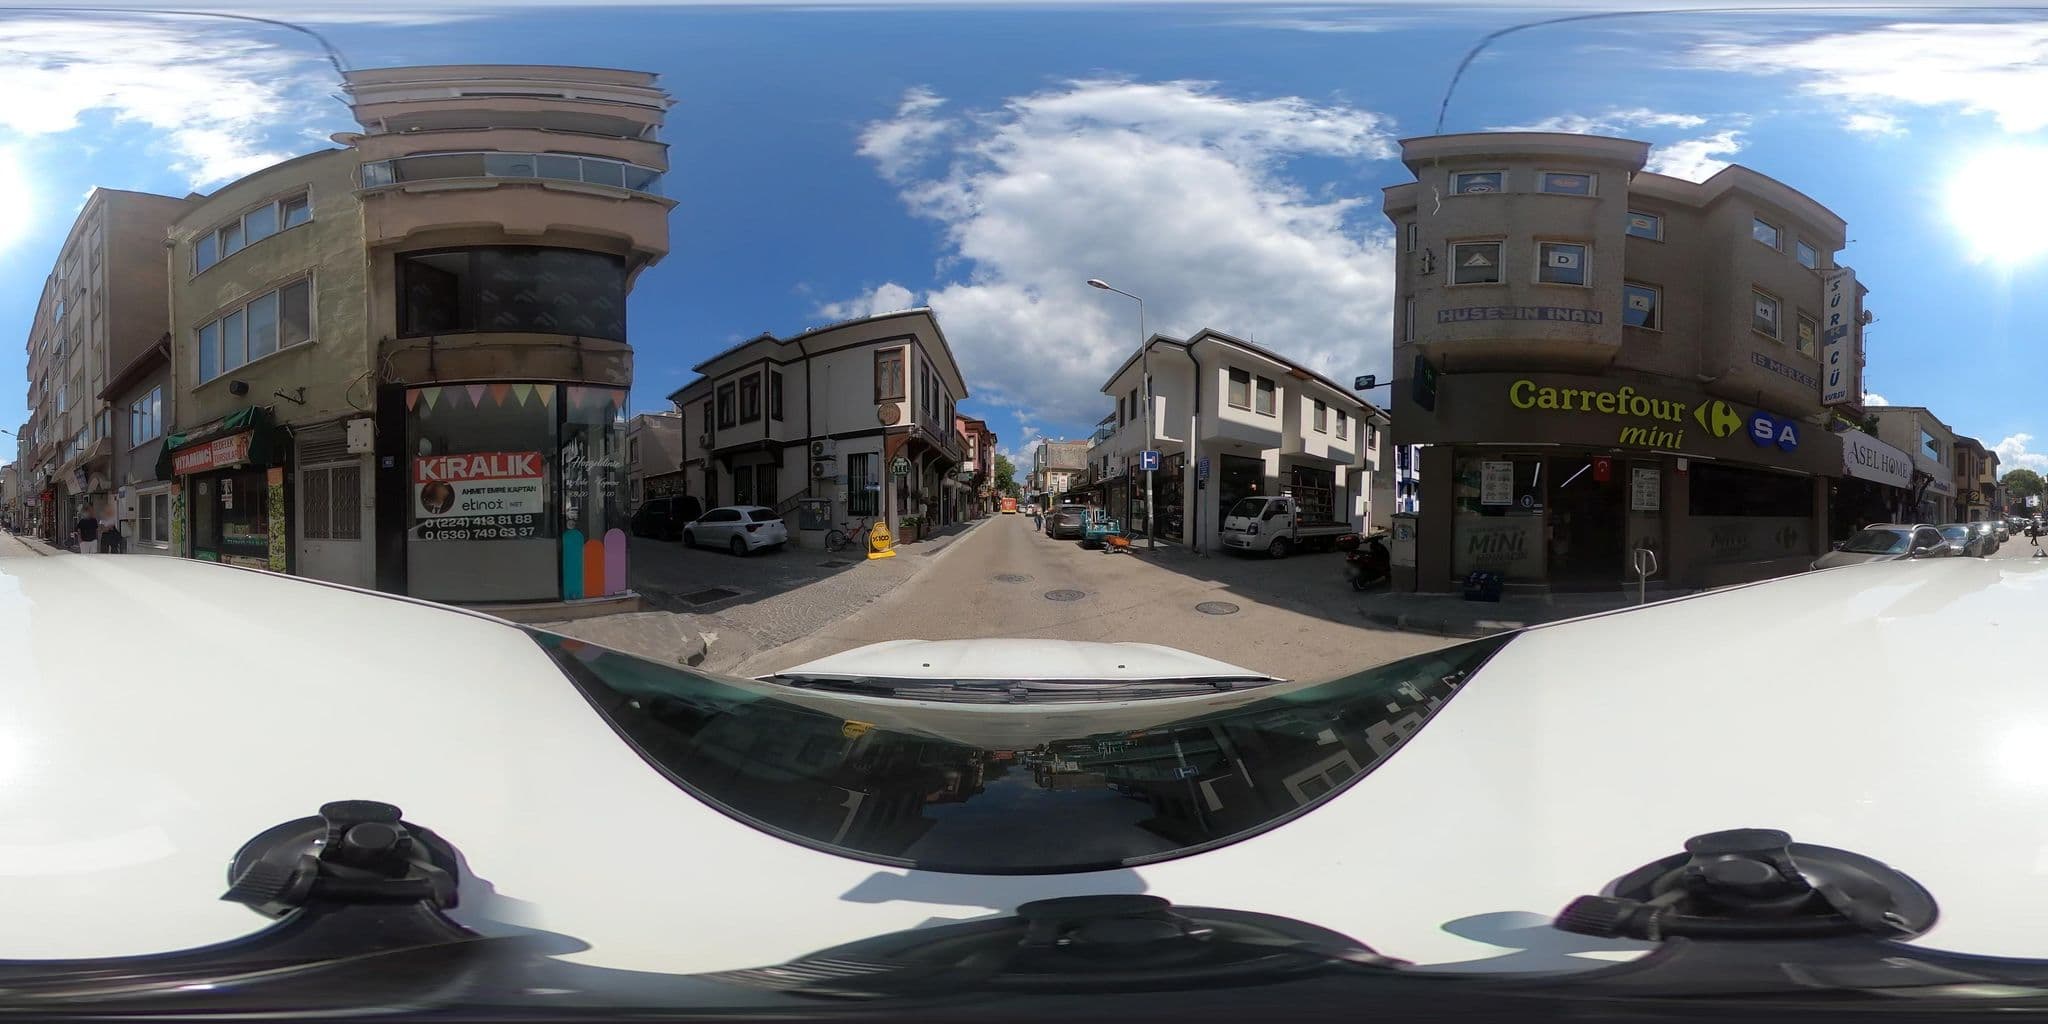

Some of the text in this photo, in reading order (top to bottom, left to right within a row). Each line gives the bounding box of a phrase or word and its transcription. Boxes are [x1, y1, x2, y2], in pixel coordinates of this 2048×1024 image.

[1830, 280, 1841, 386] SÜRCÜ
[1509, 379, 1797, 445] Carrefour SA
[1619, 425, 1685, 449] mini
[1848, 441, 1908, 479] ASEL HOME
[462, 498, 504, 511] etinox
[425, 531, 434, 540] 0
[437, 529, 471, 540] (536)
[473, 528, 496, 538] 749
[519, 527, 535, 536] 37
[436, 518, 470, 528] (224)
[472, 516, 495, 526] 413
[515, 515, 533, 524] 88
